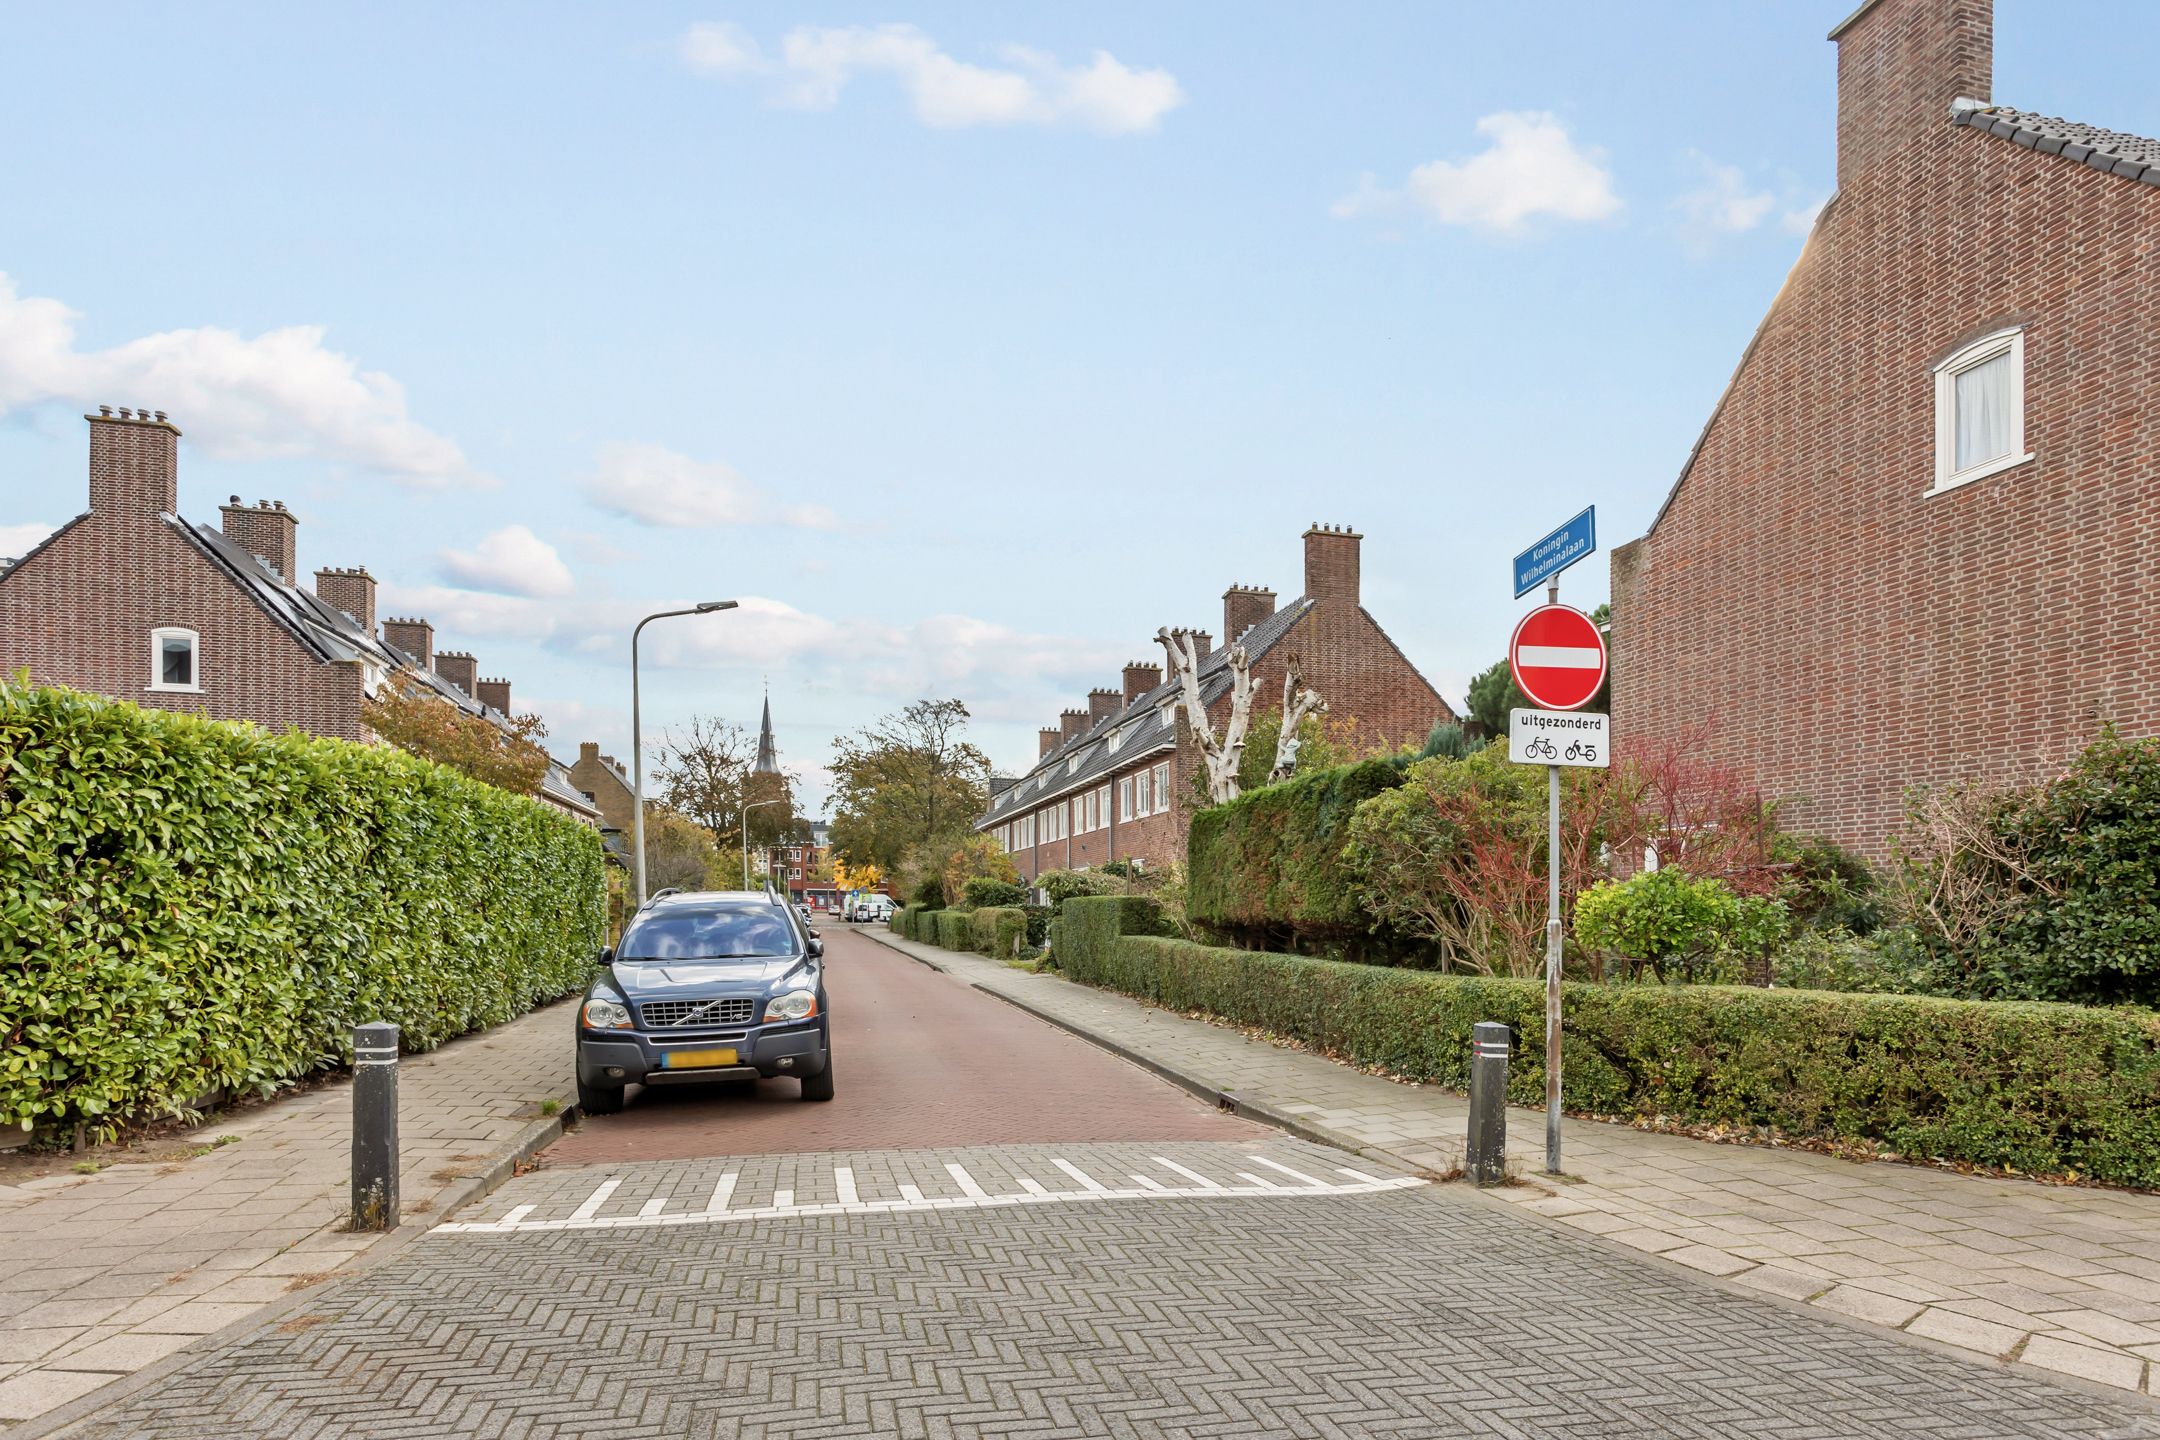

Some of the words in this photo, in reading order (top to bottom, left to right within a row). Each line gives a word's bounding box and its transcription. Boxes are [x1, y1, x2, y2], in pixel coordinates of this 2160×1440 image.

[1521, 538, 1584, 585] Wilhelminalaan
[1533, 531, 1569, 562] Koningin
[1521, 714, 1602, 730] uitgezonderd
